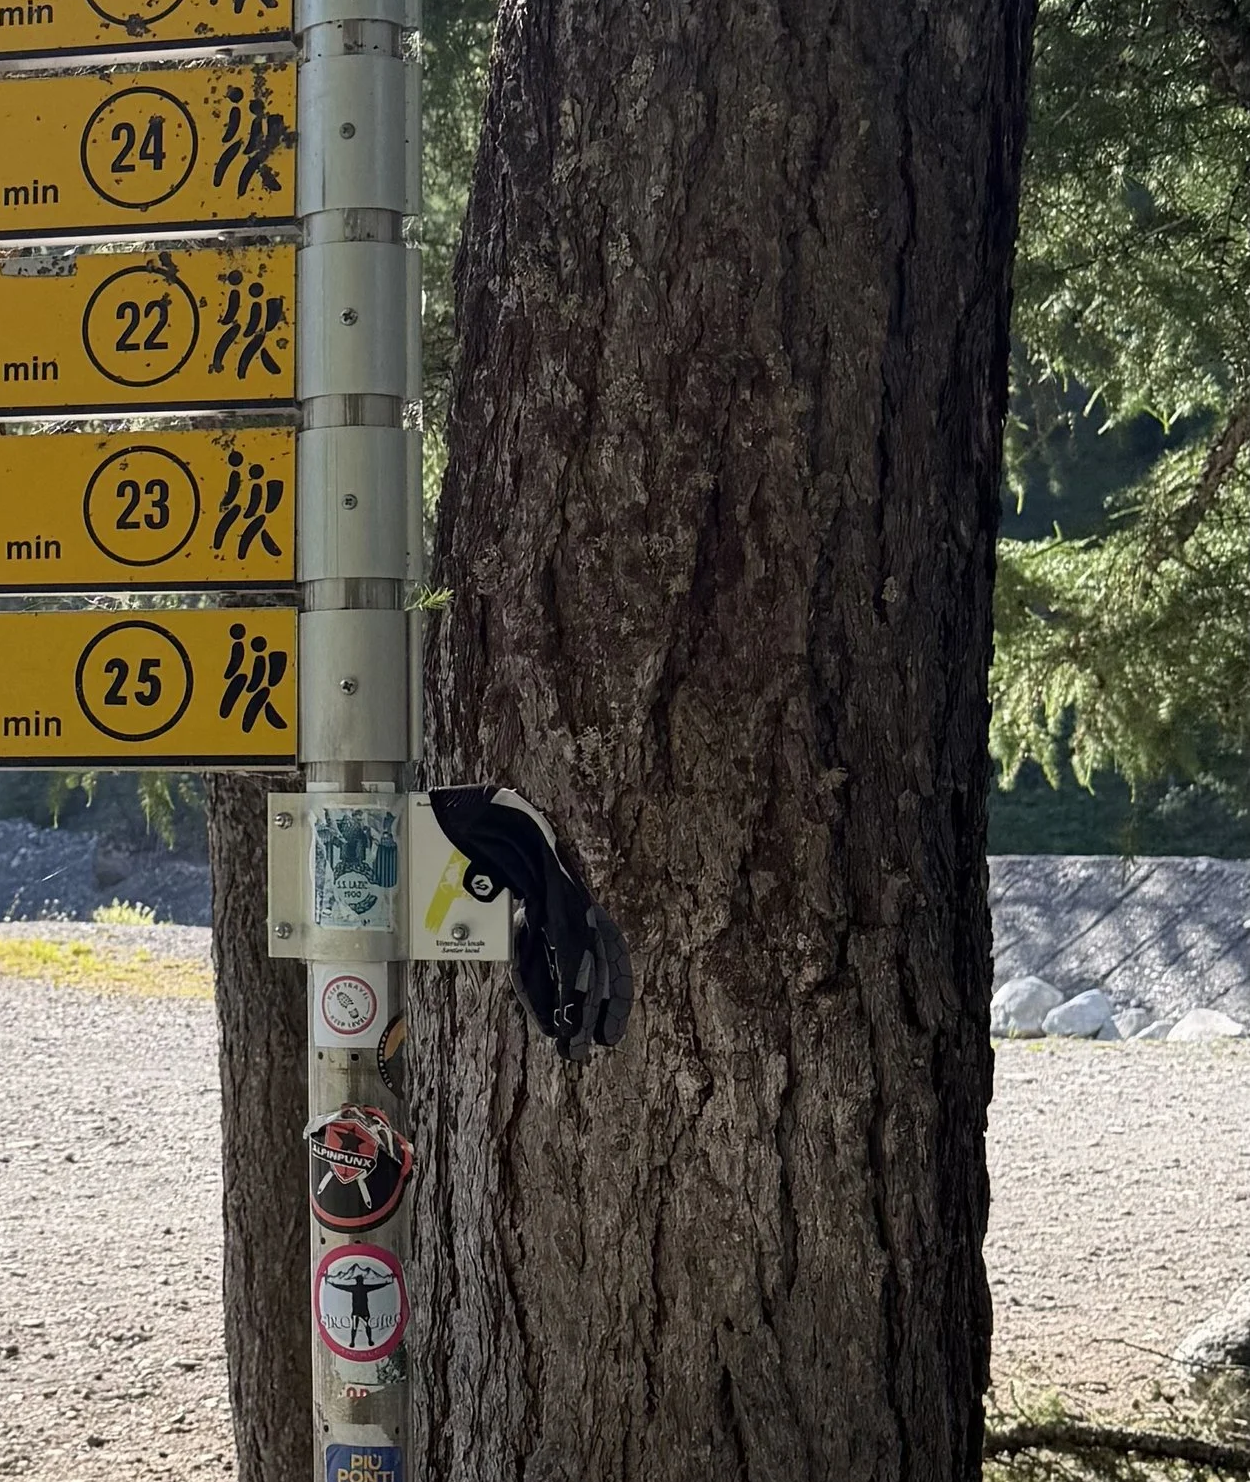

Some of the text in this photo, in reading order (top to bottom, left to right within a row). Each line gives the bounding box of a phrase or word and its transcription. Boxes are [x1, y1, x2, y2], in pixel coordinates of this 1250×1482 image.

[110, 122, 167, 173] 24
[3, 179, 59, 207] min
[115, 296, 173, 353] 22
[115, 301, 169, 352] 00
[3, 355, 59, 382] min
[116, 478, 170, 530] 23
[6, 534, 61, 561] min
[103, 657, 162, 707] 25
[3, 710, 62, 738] min
[312, 1143, 373, 1168] ALPINPUNX
[351, 1453, 383, 1470] PIÙ
